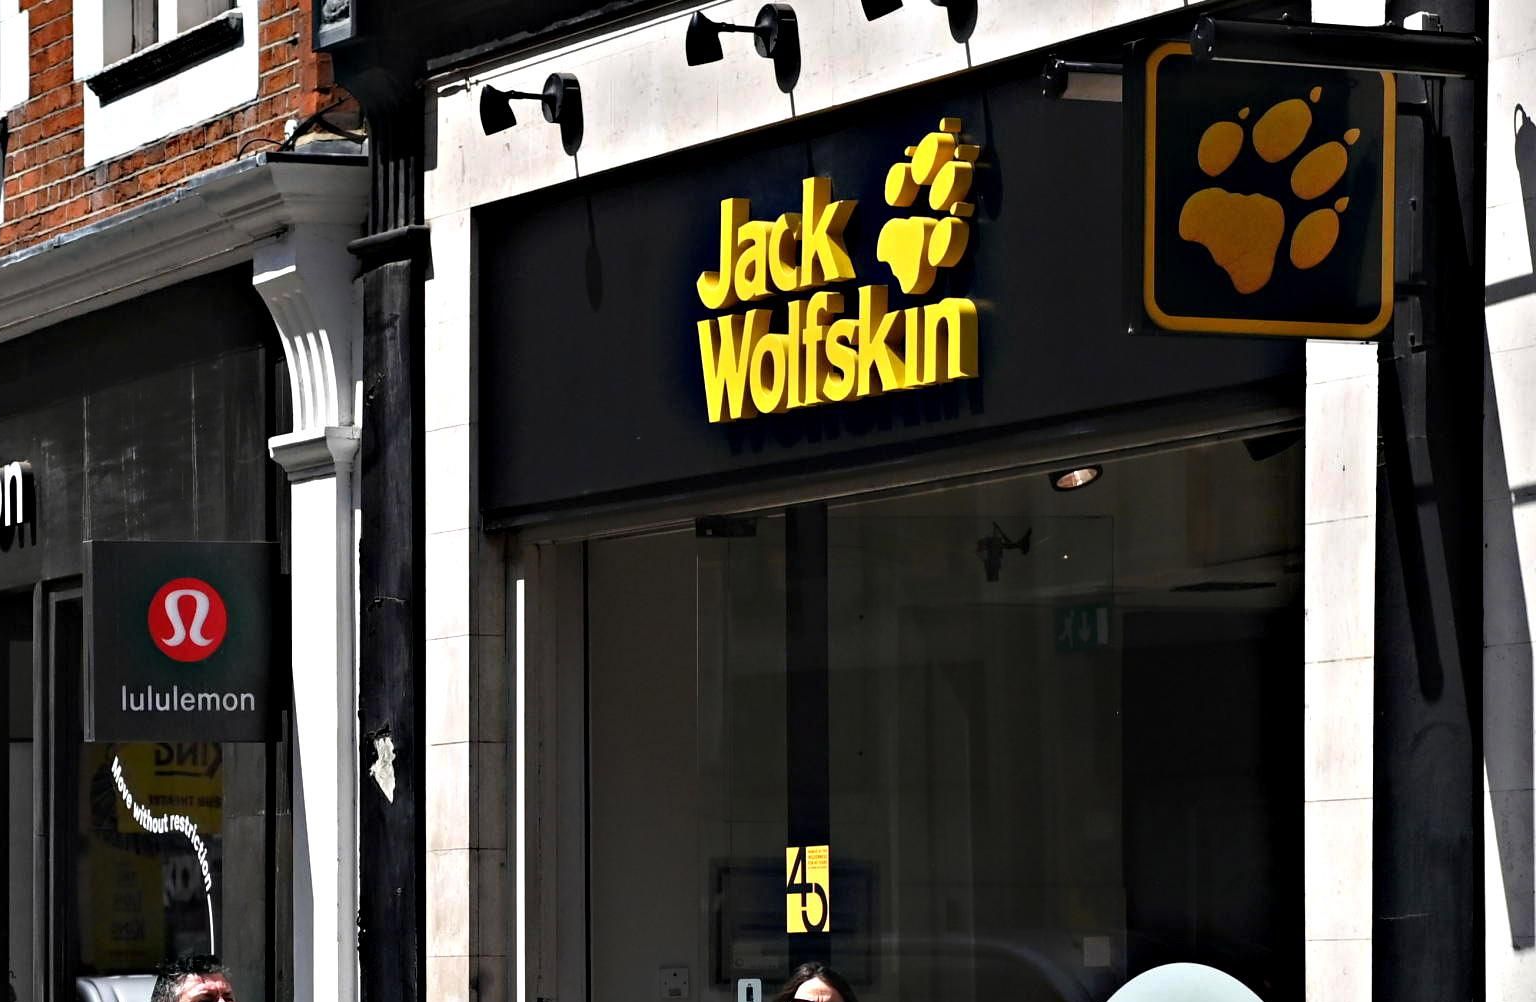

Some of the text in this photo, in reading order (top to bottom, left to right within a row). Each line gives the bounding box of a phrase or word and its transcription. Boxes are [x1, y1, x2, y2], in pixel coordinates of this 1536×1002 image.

[697, 177, 857, 309] Jack
[697, 285, 978, 423] Wolfskin
[121, 685, 255, 712] lululemon
[111, 755, 133, 809] Move
[133, 802, 169, 834] without
[169, 815, 212, 892] restriction
